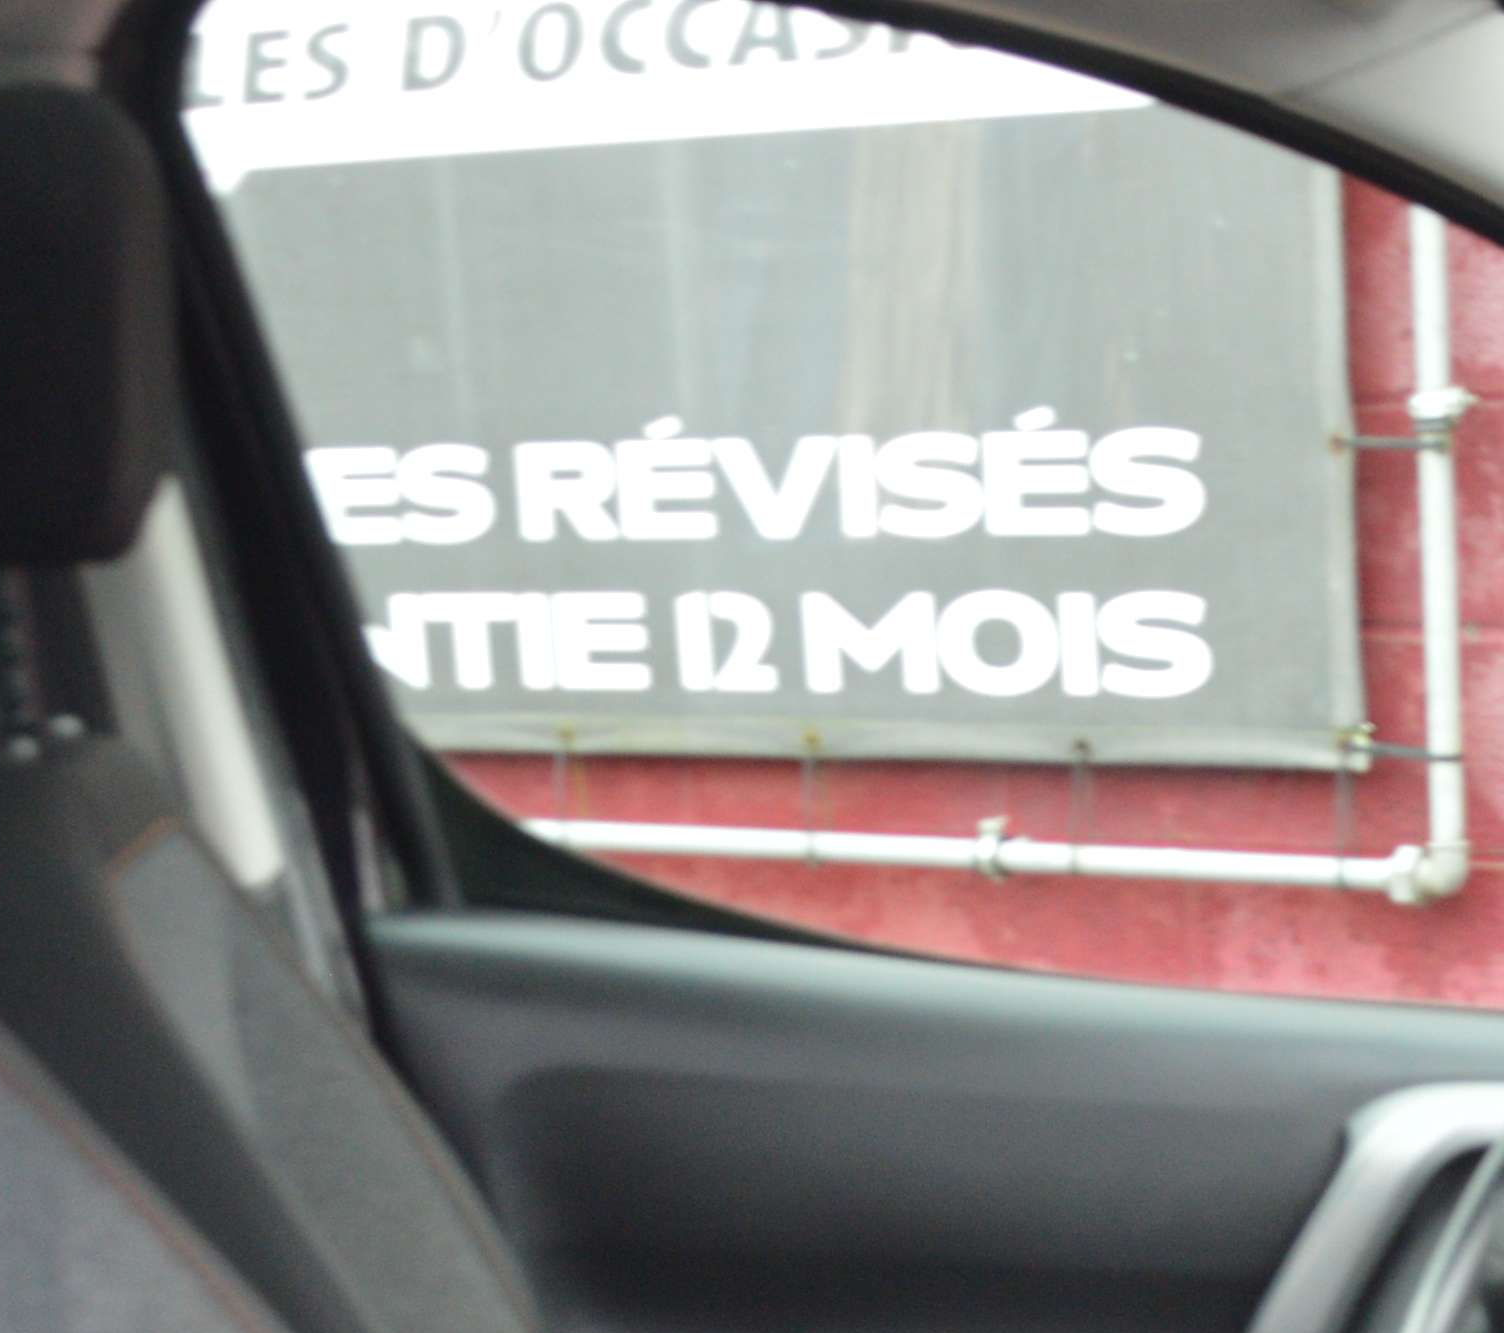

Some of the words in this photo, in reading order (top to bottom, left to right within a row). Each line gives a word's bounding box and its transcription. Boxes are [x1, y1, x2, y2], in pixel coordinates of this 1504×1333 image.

[512, 404, 1207, 543] RÉVISÉS
[674, 589, 780, 694] 12
[800, 587, 1214, 700] MOIS
